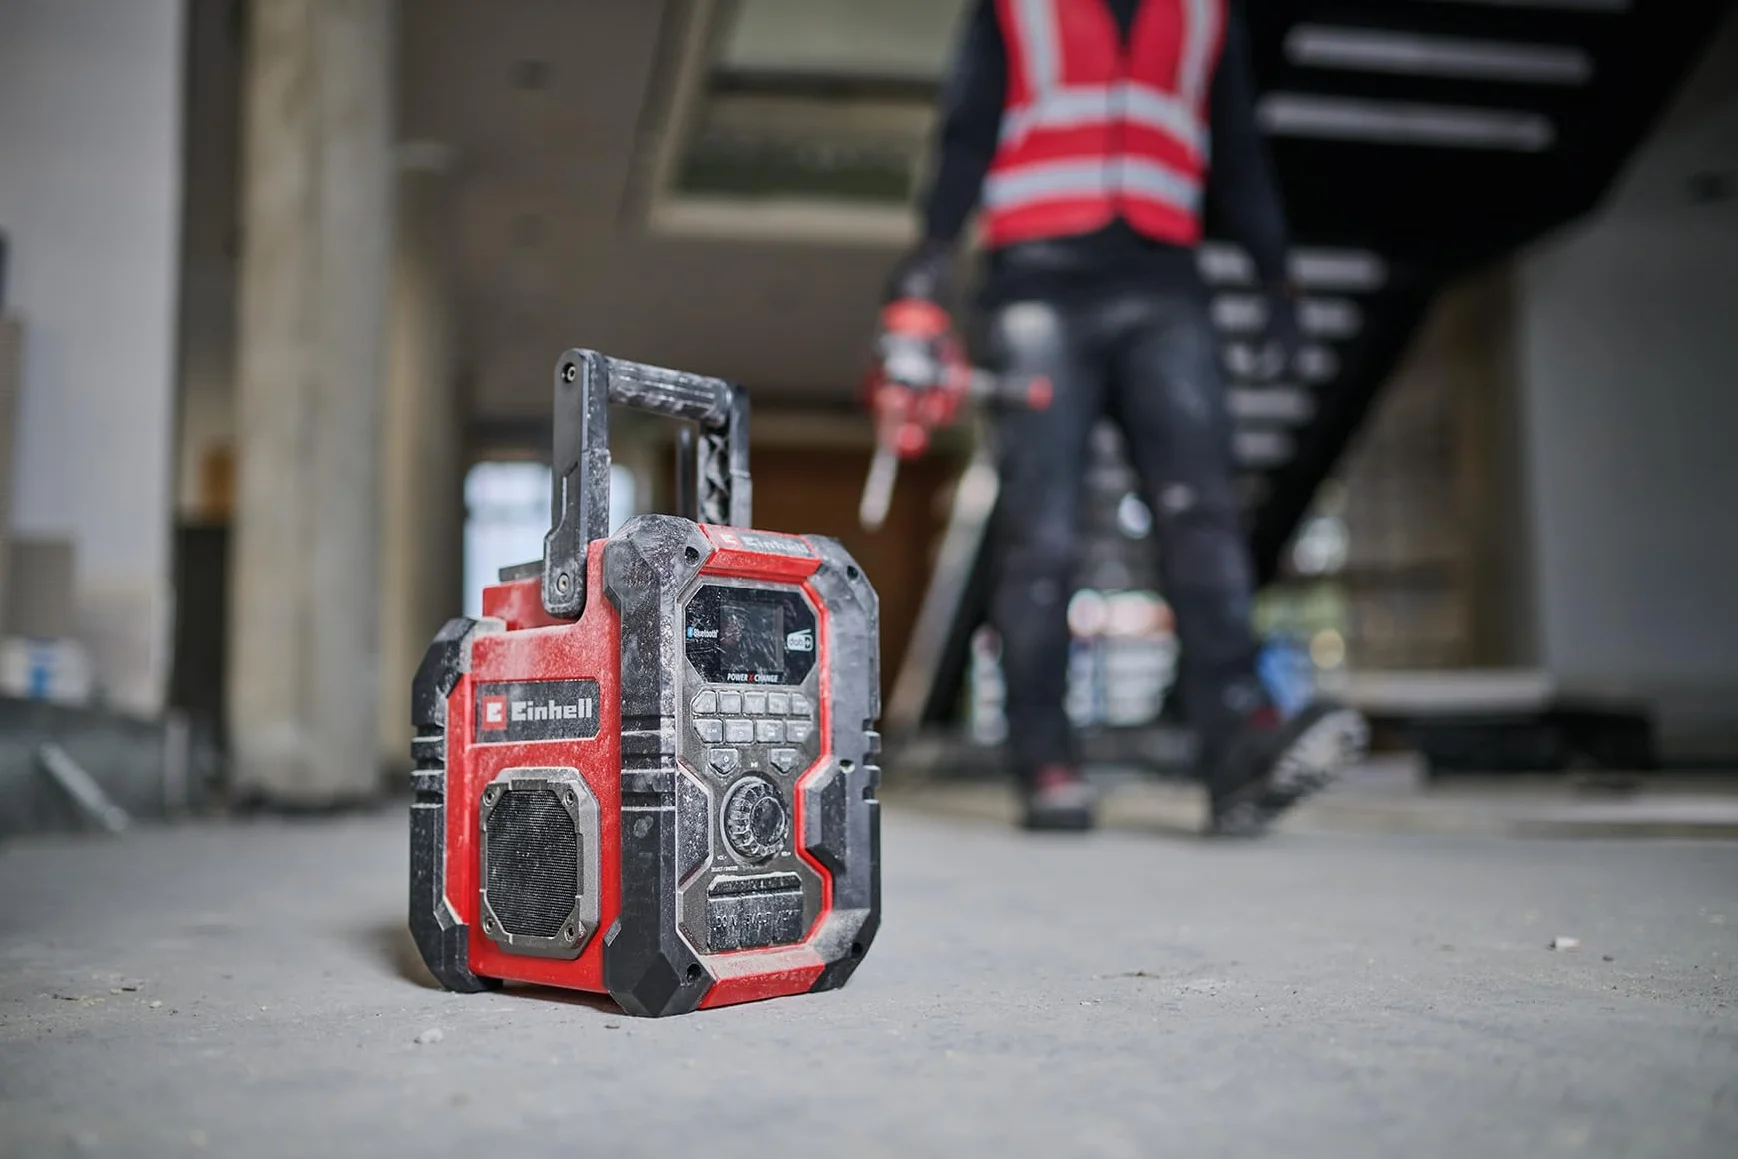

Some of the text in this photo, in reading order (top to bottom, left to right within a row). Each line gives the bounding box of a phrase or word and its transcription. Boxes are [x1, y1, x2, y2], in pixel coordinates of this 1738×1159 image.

[741, 536, 809, 553] Einhell
[727, 672, 748, 682] POWER
[511, 698, 592, 721] Einhell
